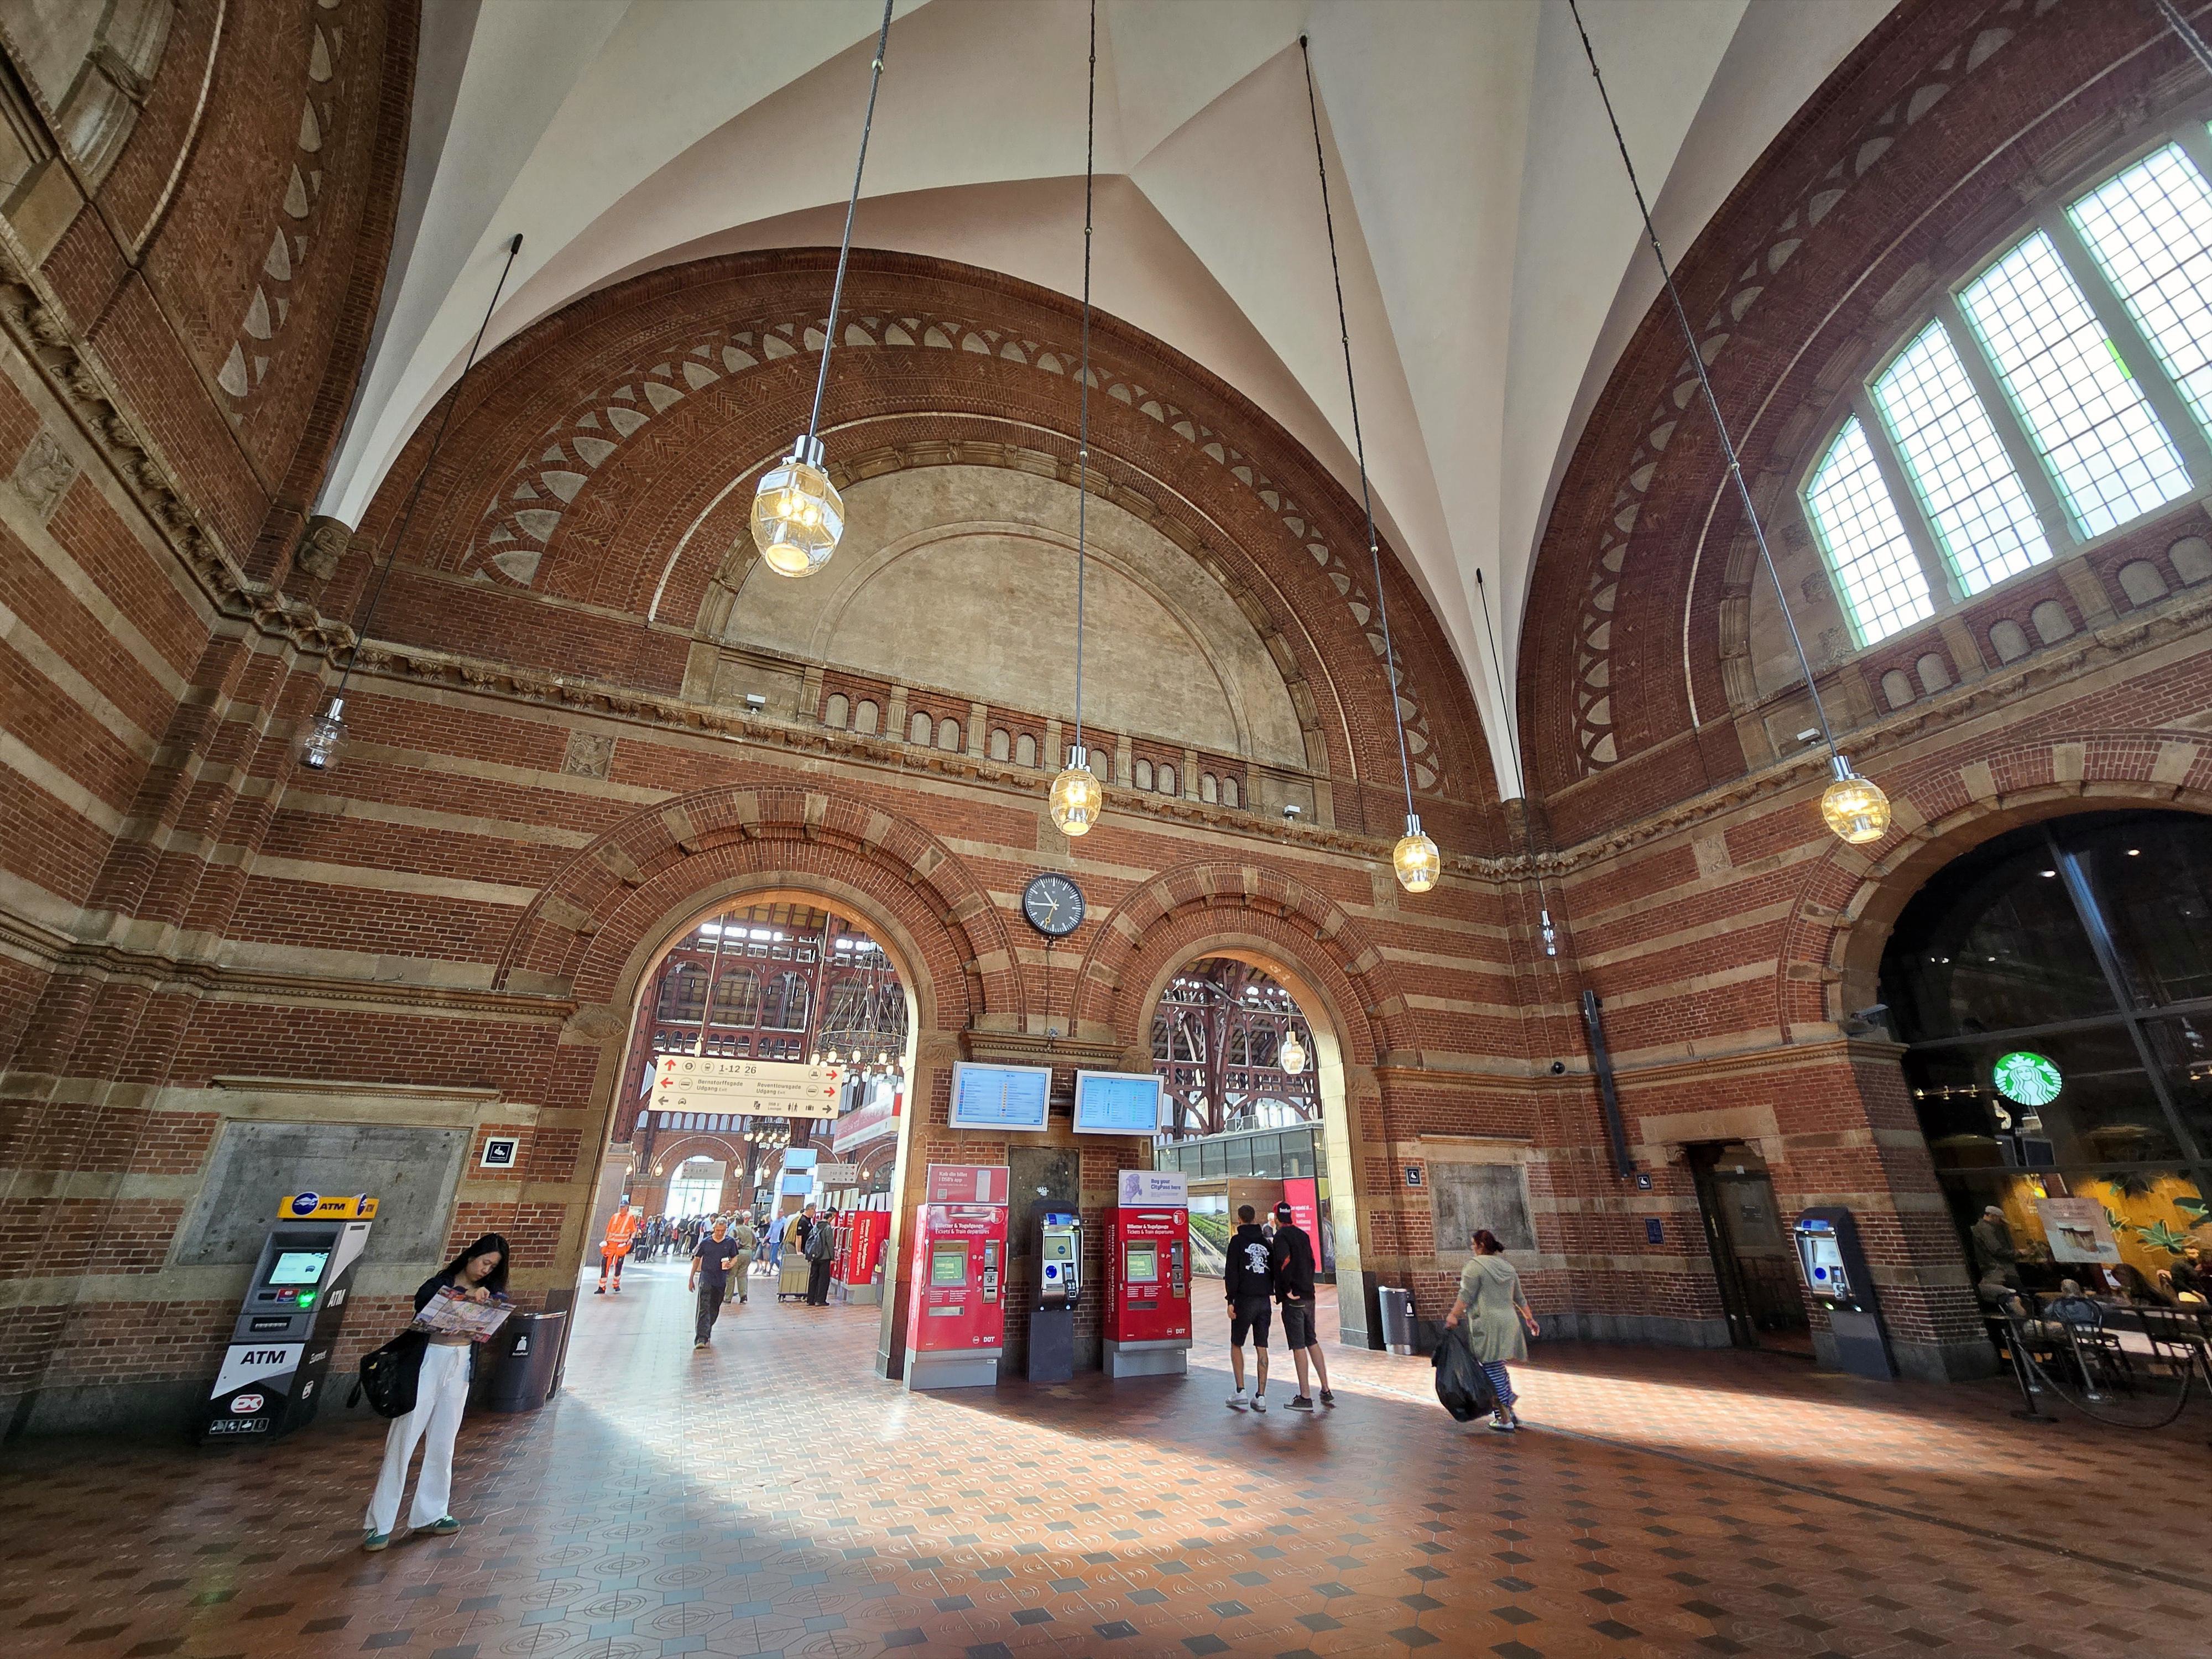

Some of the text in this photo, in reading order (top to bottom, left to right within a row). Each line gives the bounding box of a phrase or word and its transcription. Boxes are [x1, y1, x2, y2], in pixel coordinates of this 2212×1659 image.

[719, 1065, 740, 1073] 1-12
[327, 1288, 346, 1308] ATM
[240, 1350, 286, 1365] ATM
